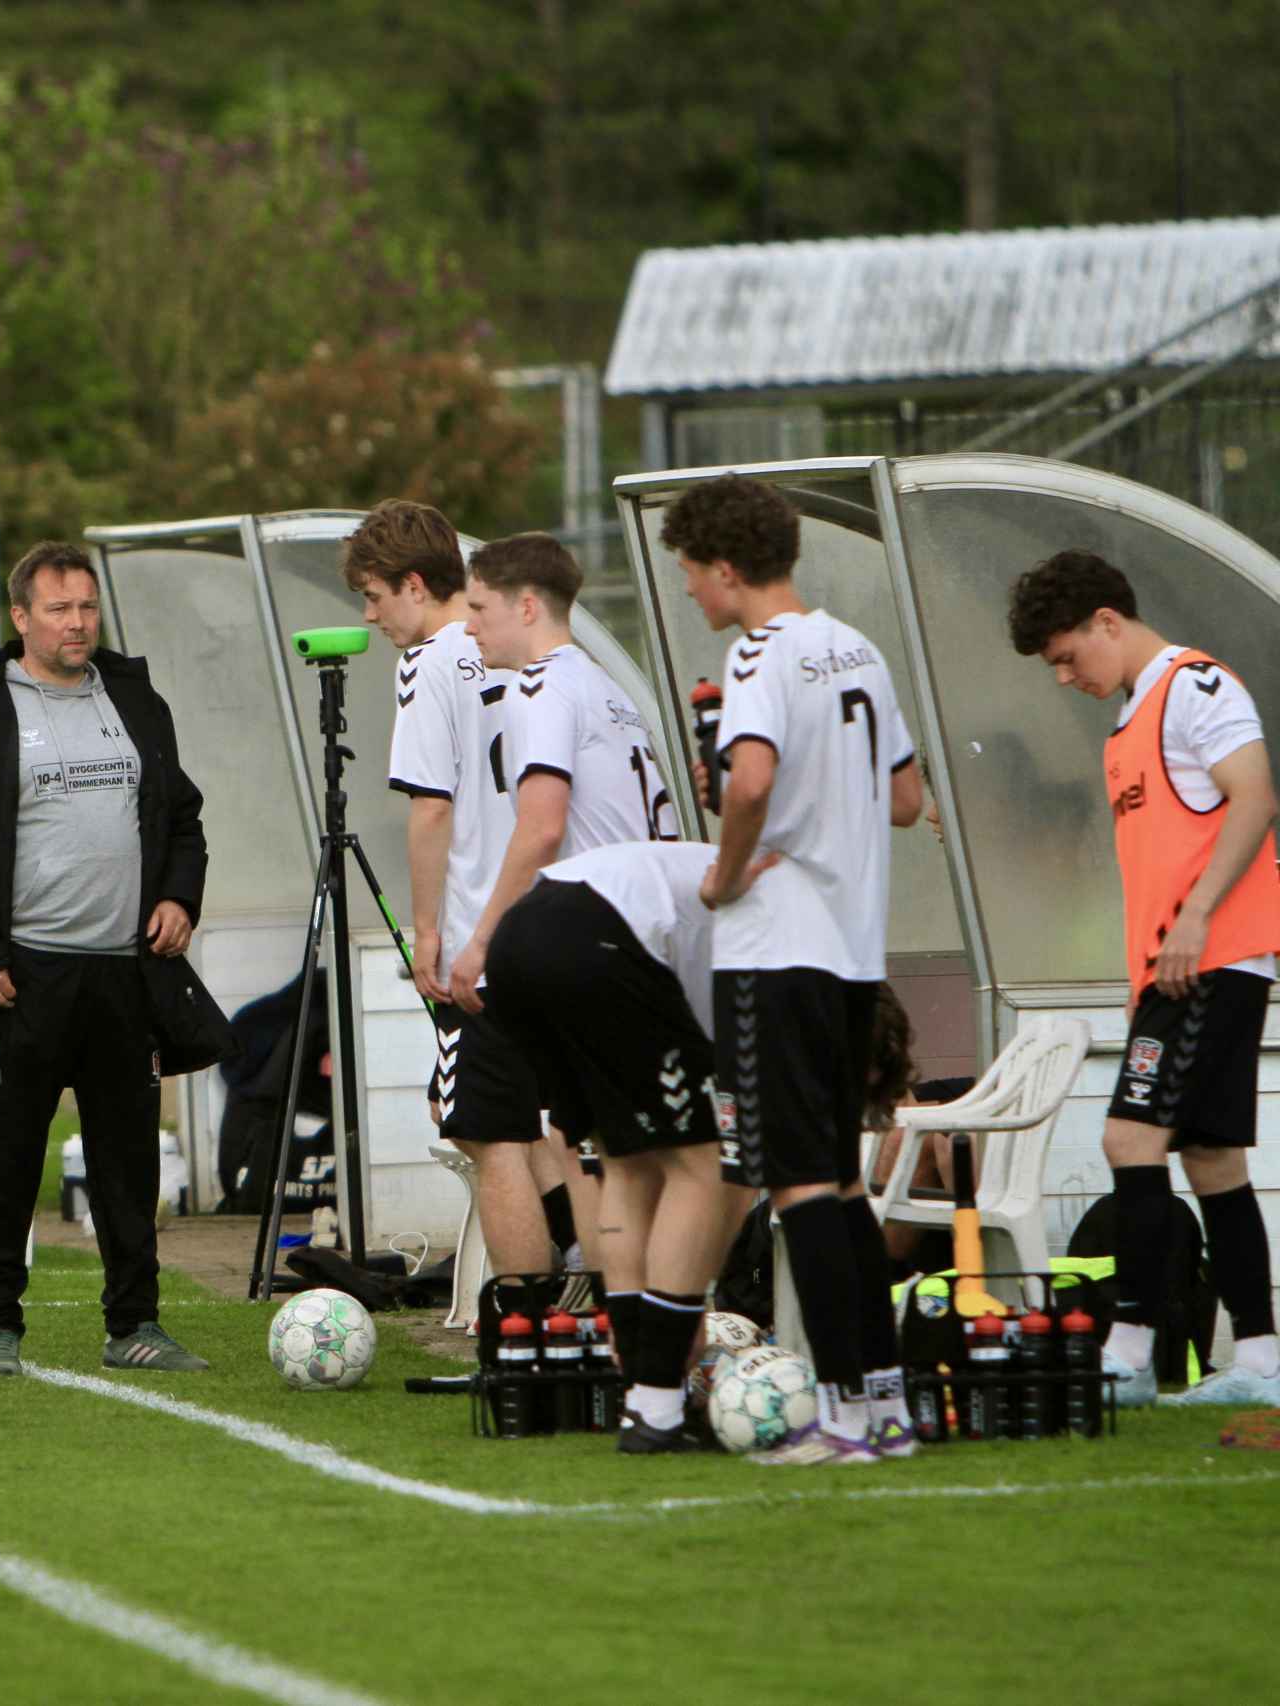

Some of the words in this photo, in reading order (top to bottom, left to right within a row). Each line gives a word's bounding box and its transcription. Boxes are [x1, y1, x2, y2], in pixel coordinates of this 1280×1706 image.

[840, 687, 879, 801] 7
[36, 771, 62, 786] 10-4
[68, 775, 137, 790] TØMMERHANEL
